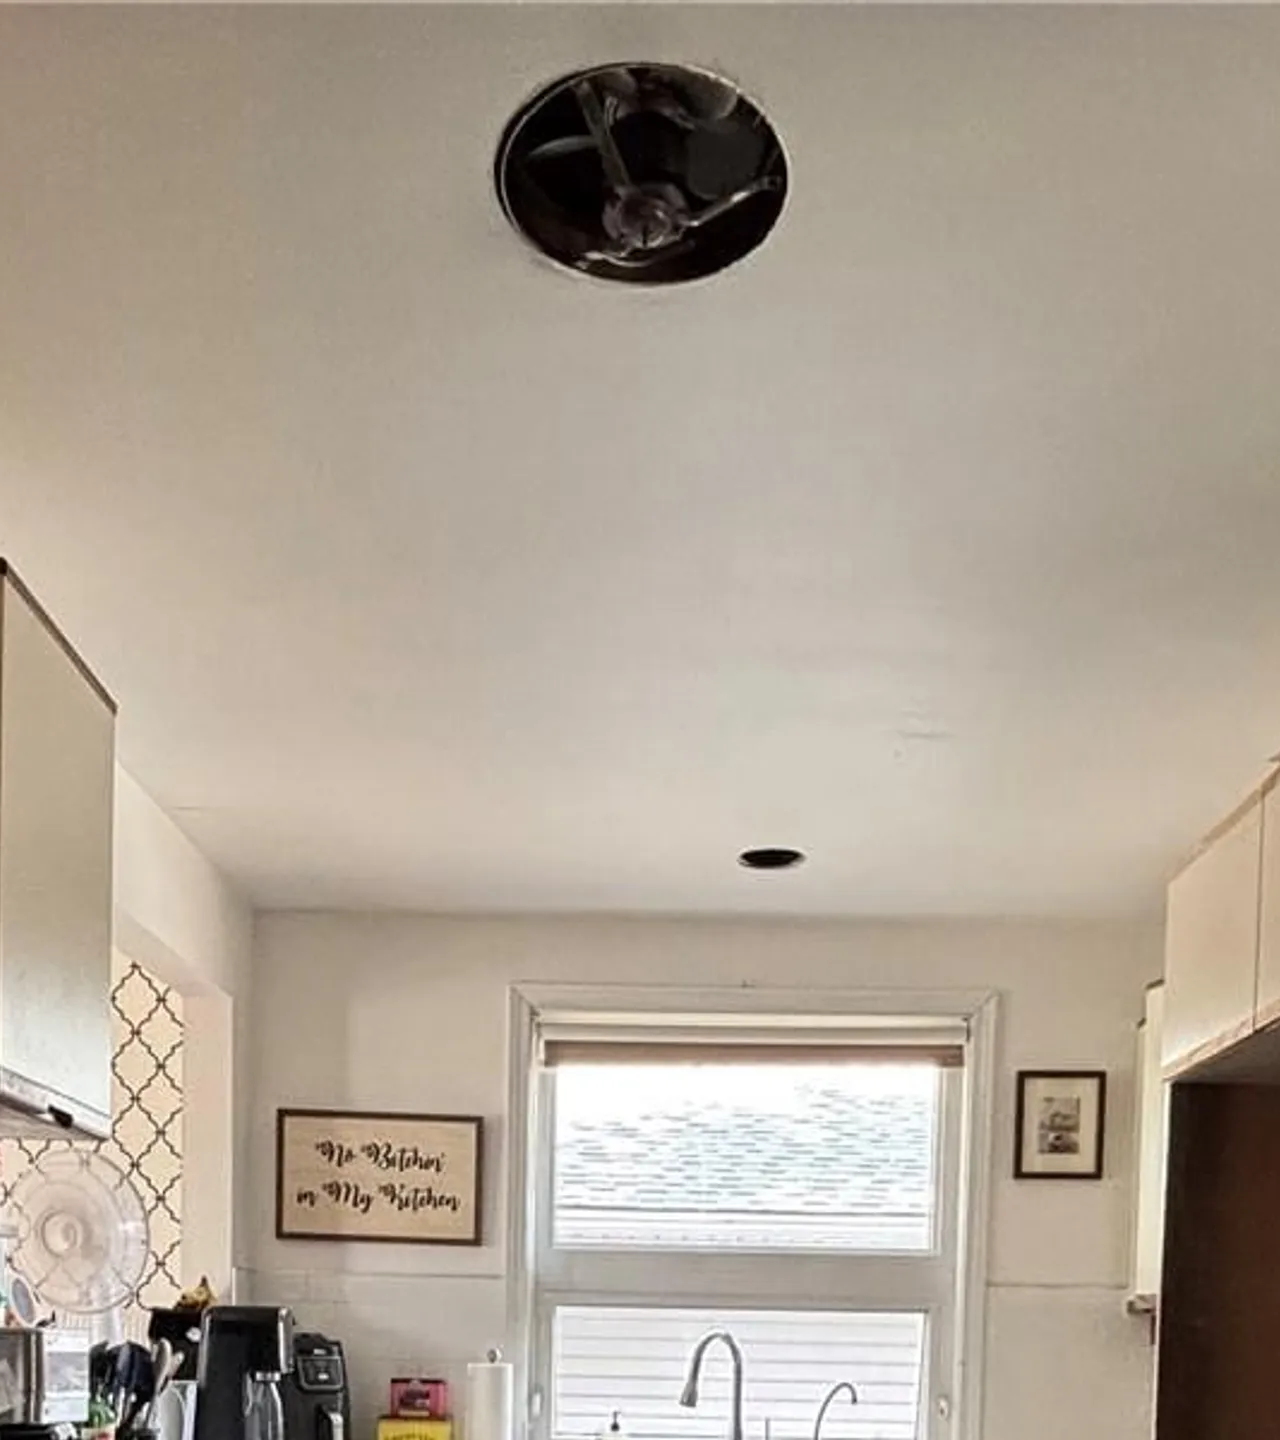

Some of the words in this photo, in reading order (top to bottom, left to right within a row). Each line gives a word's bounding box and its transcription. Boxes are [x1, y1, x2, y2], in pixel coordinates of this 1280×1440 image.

[316, 1140, 355, 1168] No
[322, 1181, 375, 1214] My
[378, 1183, 461, 1212] Kitchen
